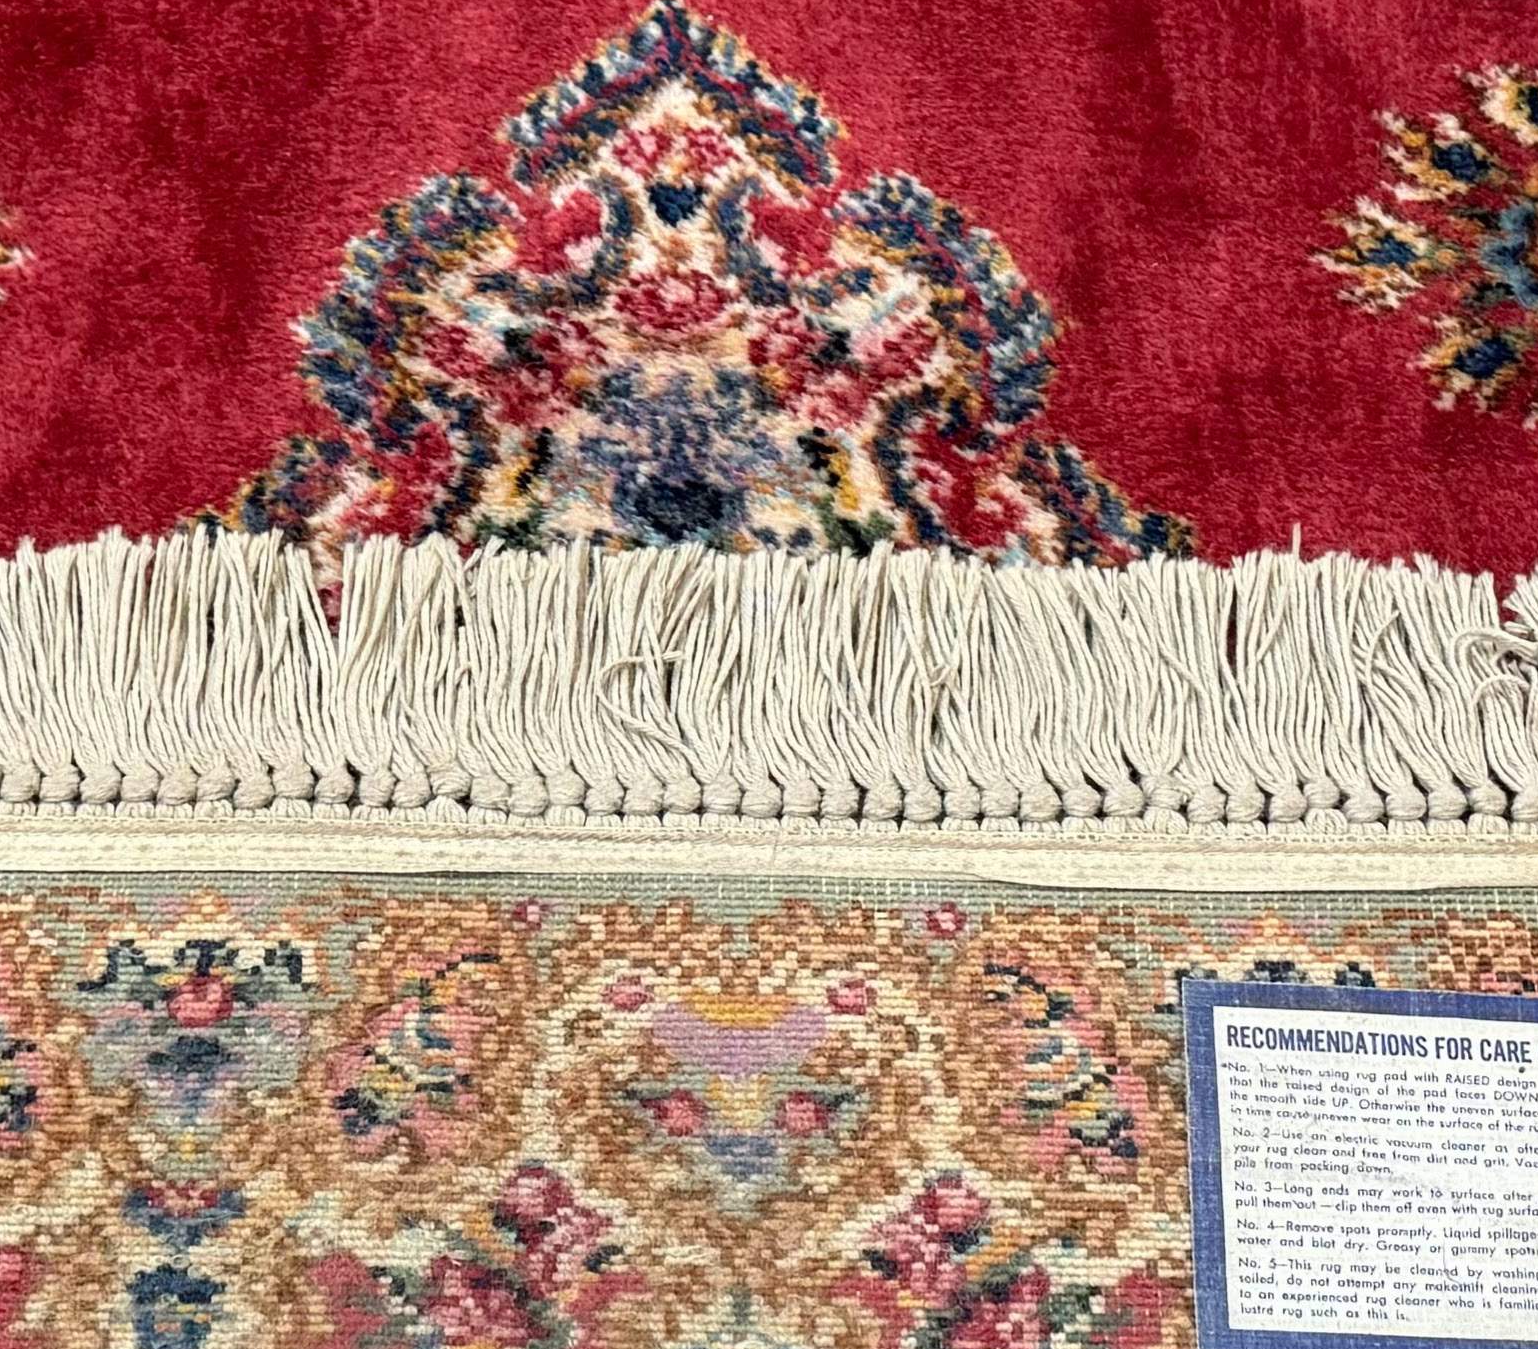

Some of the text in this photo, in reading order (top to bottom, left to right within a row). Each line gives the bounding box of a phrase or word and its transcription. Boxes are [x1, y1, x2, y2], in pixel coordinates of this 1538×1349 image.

[1226, 1024, 1428, 1057] RECOMMENDATIONS
[1434, 1035, 1473, 1060] FOR
[1479, 1038, 1532, 1063] CARE
[1227, 1061, 1249, 1072] No.
[1318, 1068, 1349, 1082] using
[1356, 1071, 1376, 1083] rug
[1383, 1070, 1407, 1084] pad
[1413, 1071, 1438, 1082] with
[1445, 1073, 1490, 1085] RAISED
[1497, 1076, 1536, 1091] design
[1229, 1075, 1252, 1086] that
[1259, 1077, 1278, 1088] the
[1285, 1079, 1322, 1090] raised
[1330, 1082, 1369, 1097] design
[1396, 1085, 1415, 1096] the
[1423, 1086, 1447, 1101] pad
[1455, 1088, 1486, 1099] faces
[1492, 1090, 1538, 1102] DOWN
[1229, 1089, 1248, 1100] the
[1254, 1091, 1296, 1103] smooth
[1302, 1094, 1326, 1105] side
[1358, 1098, 1420, 1111] Otherwise
[1426, 1101, 1445, 1112] the
[1452, 1106, 1494, 1115] uneven
[1246, 1105, 1271, 1116] time
[1361, 1115, 1390, 1124] wear
[1416, 1116, 1434, 1127] the
[1439, 1118, 1482, 1129] surface
[1504, 1121, 1524, 1132] the
[1334, 1132, 1378, 1144] electric
[1386, 1139, 1432, 1148] vacuum
[1440, 1139, 1486, 1151] cleaner
[1232, 1144, 1260, 1156] your
[1266, 1145, 1287, 1157] rug
[1293, 1144, 1327, 1155] clean
[1331, 1146, 1355, 1157] and
[1362, 1148, 1386, 1159] free
[1392, 1150, 1420, 1161] from
[1426, 1152, 1447, 1163] dirt
[1453, 1153, 1477, 1164] and
[1233, 1156, 1349, 1175] pile from packing
[1321, 1184, 1349, 1195] ends
[1357, 1188, 1383, 1200] may
[1391, 1186, 1423, 1197] work
[1450, 1188, 1495, 1200] surface
[1502, 1190, 1532, 1201] after
[1235, 1196, 1258, 1211] pull
[1262, 1197, 1291, 1208] them
[1334, 1200, 1357, 1215] clip
[1361, 1201, 1390, 1212] them
[1395, 1202, 1413, 1213] off
[1417, 1205, 1447, 1214] even
[1451, 1203, 1476, 1214] with
[1482, 1206, 1503, 1218] rug
[1340, 1224, 1371, 1238] spots
[1443, 1227, 1481, 1242] Liquid
[1237, 1234, 1271, 1244] water
[1279, 1234, 1303, 1246] and
[1311, 1236, 1335, 1247] blot
[1375, 1240, 1422, 1255] Greasy
[1450, 1245, 1496, 1258] gummy
[1320, 1262, 1341, 1275] rug
[1349, 1264, 1377, 1276] may
[1409, 1264, 1458, 1276] cleaned
[1309, 1275, 1329, 1286] not
[1337, 1277, 1385, 1292] attempt
[1392, 1281, 1417, 1293] any
[1424, 1280, 1484, 1292] makeshift
[1281, 1289, 1358, 1306] experienced
[1365, 1294, 1387, 1307] rug
[1394, 1294, 1440, 1306] cleaner
[1448, 1296, 1474, 1307] who
[1282, 1307, 1303, 1319] rug
[1310, 1305, 1337, 1316] such
[1367, 1307, 1388, 1318] this
